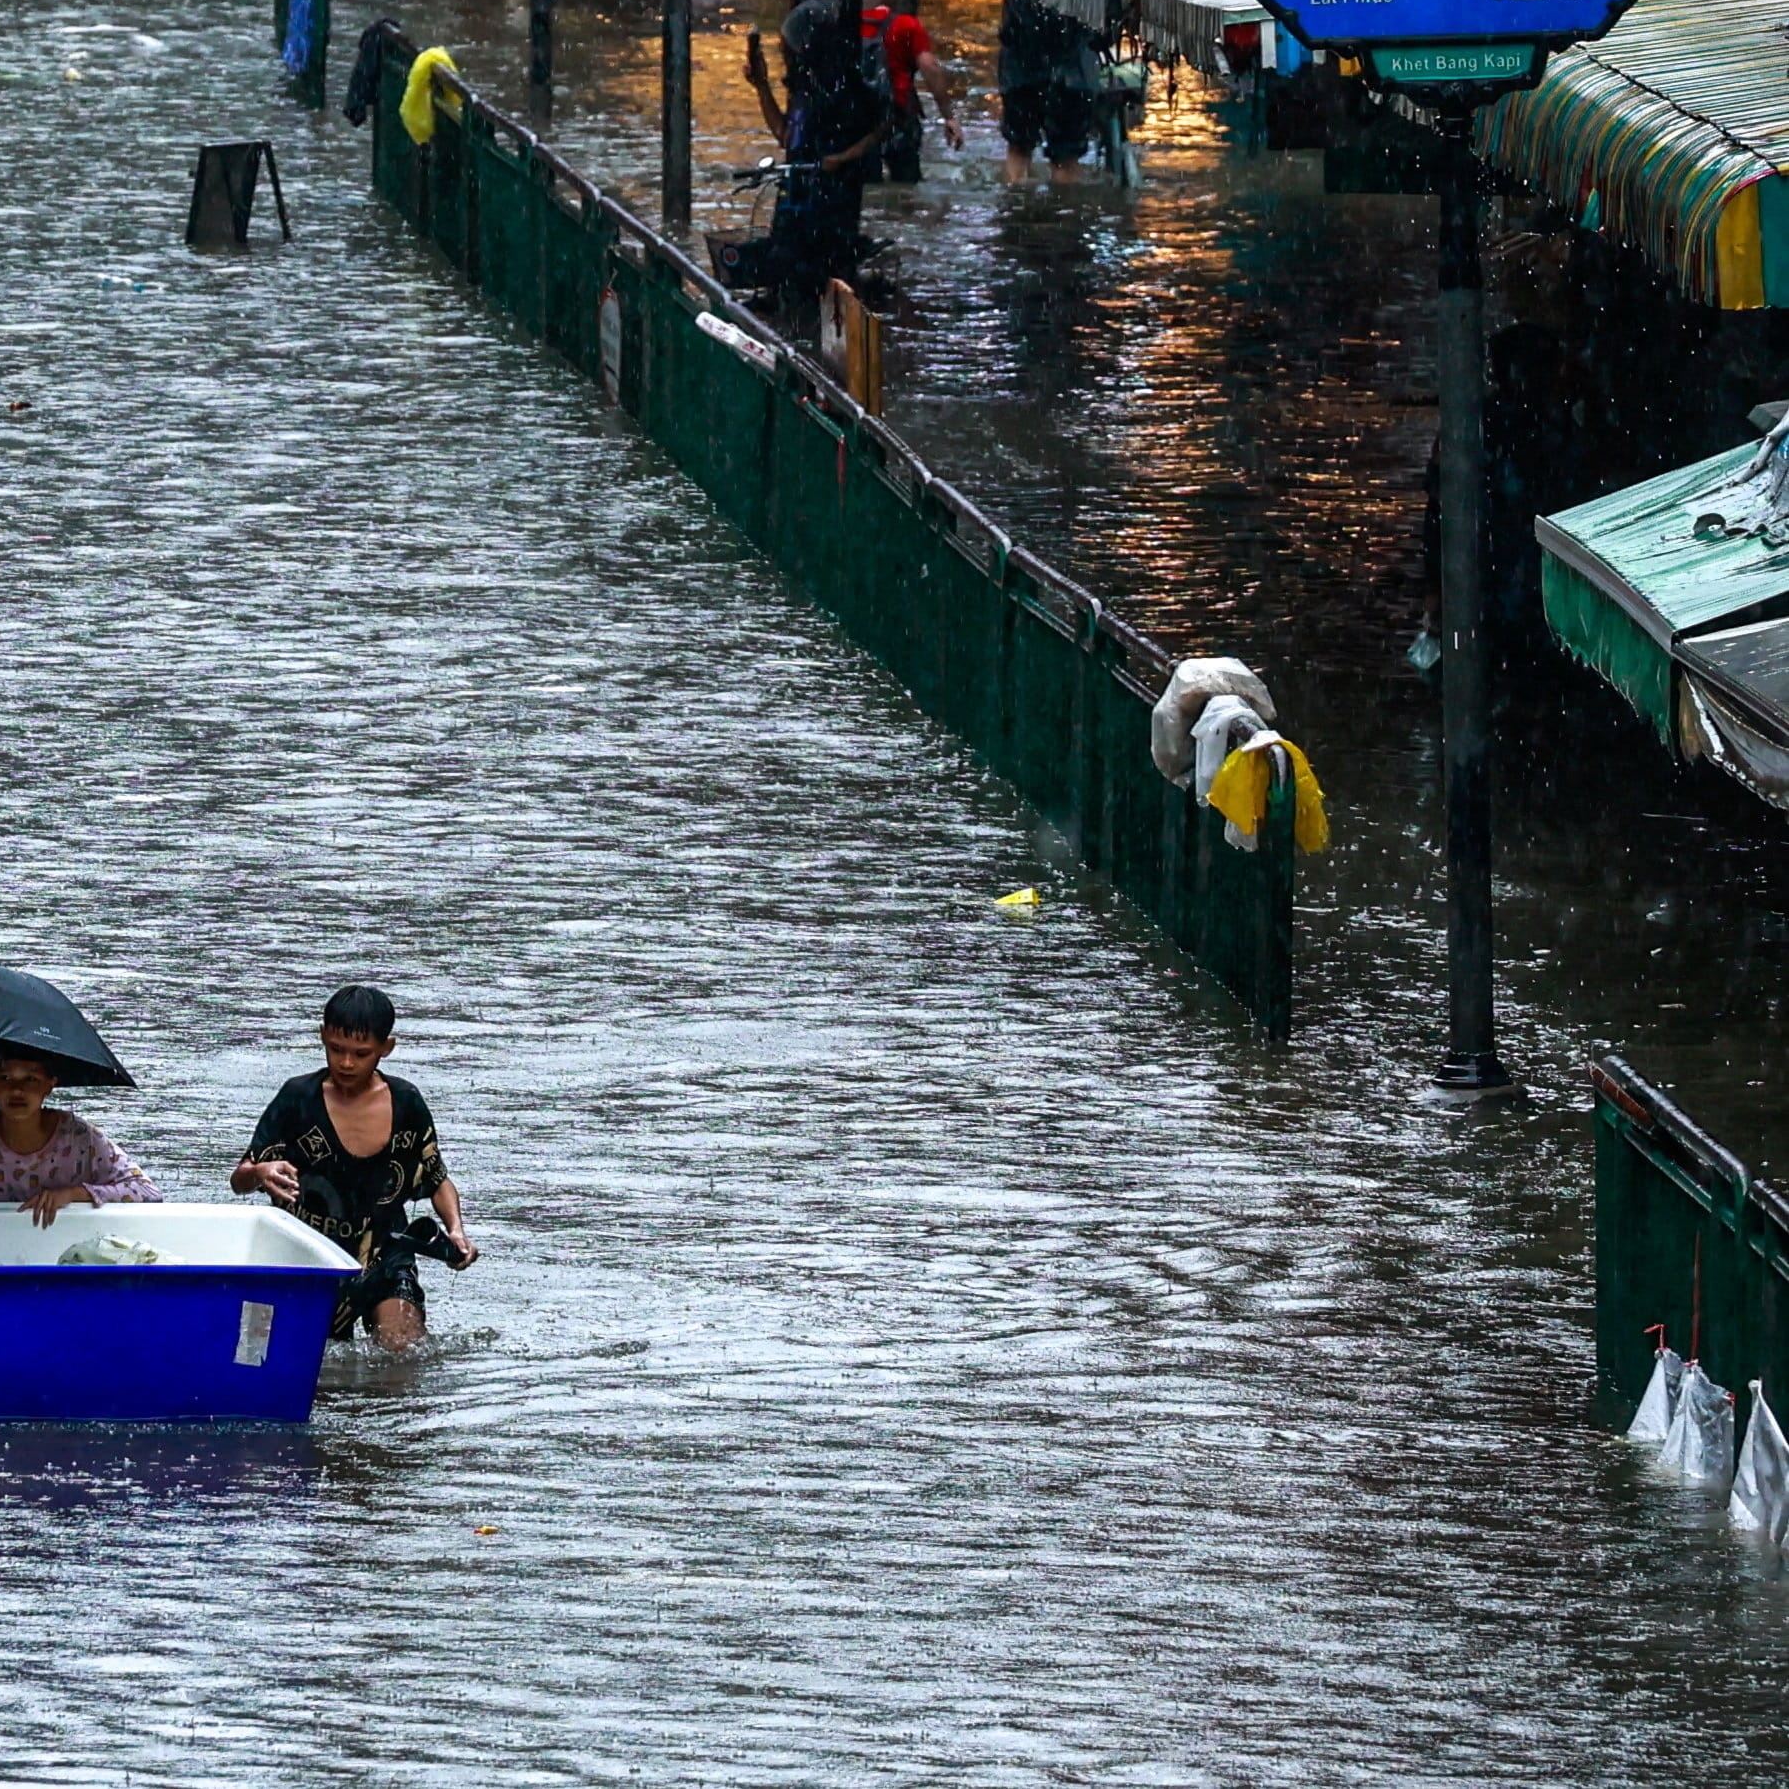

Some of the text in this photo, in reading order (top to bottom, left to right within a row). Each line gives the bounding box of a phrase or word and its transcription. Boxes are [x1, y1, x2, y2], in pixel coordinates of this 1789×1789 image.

[1391, 52, 1522, 73] Khet Bang Kapi
